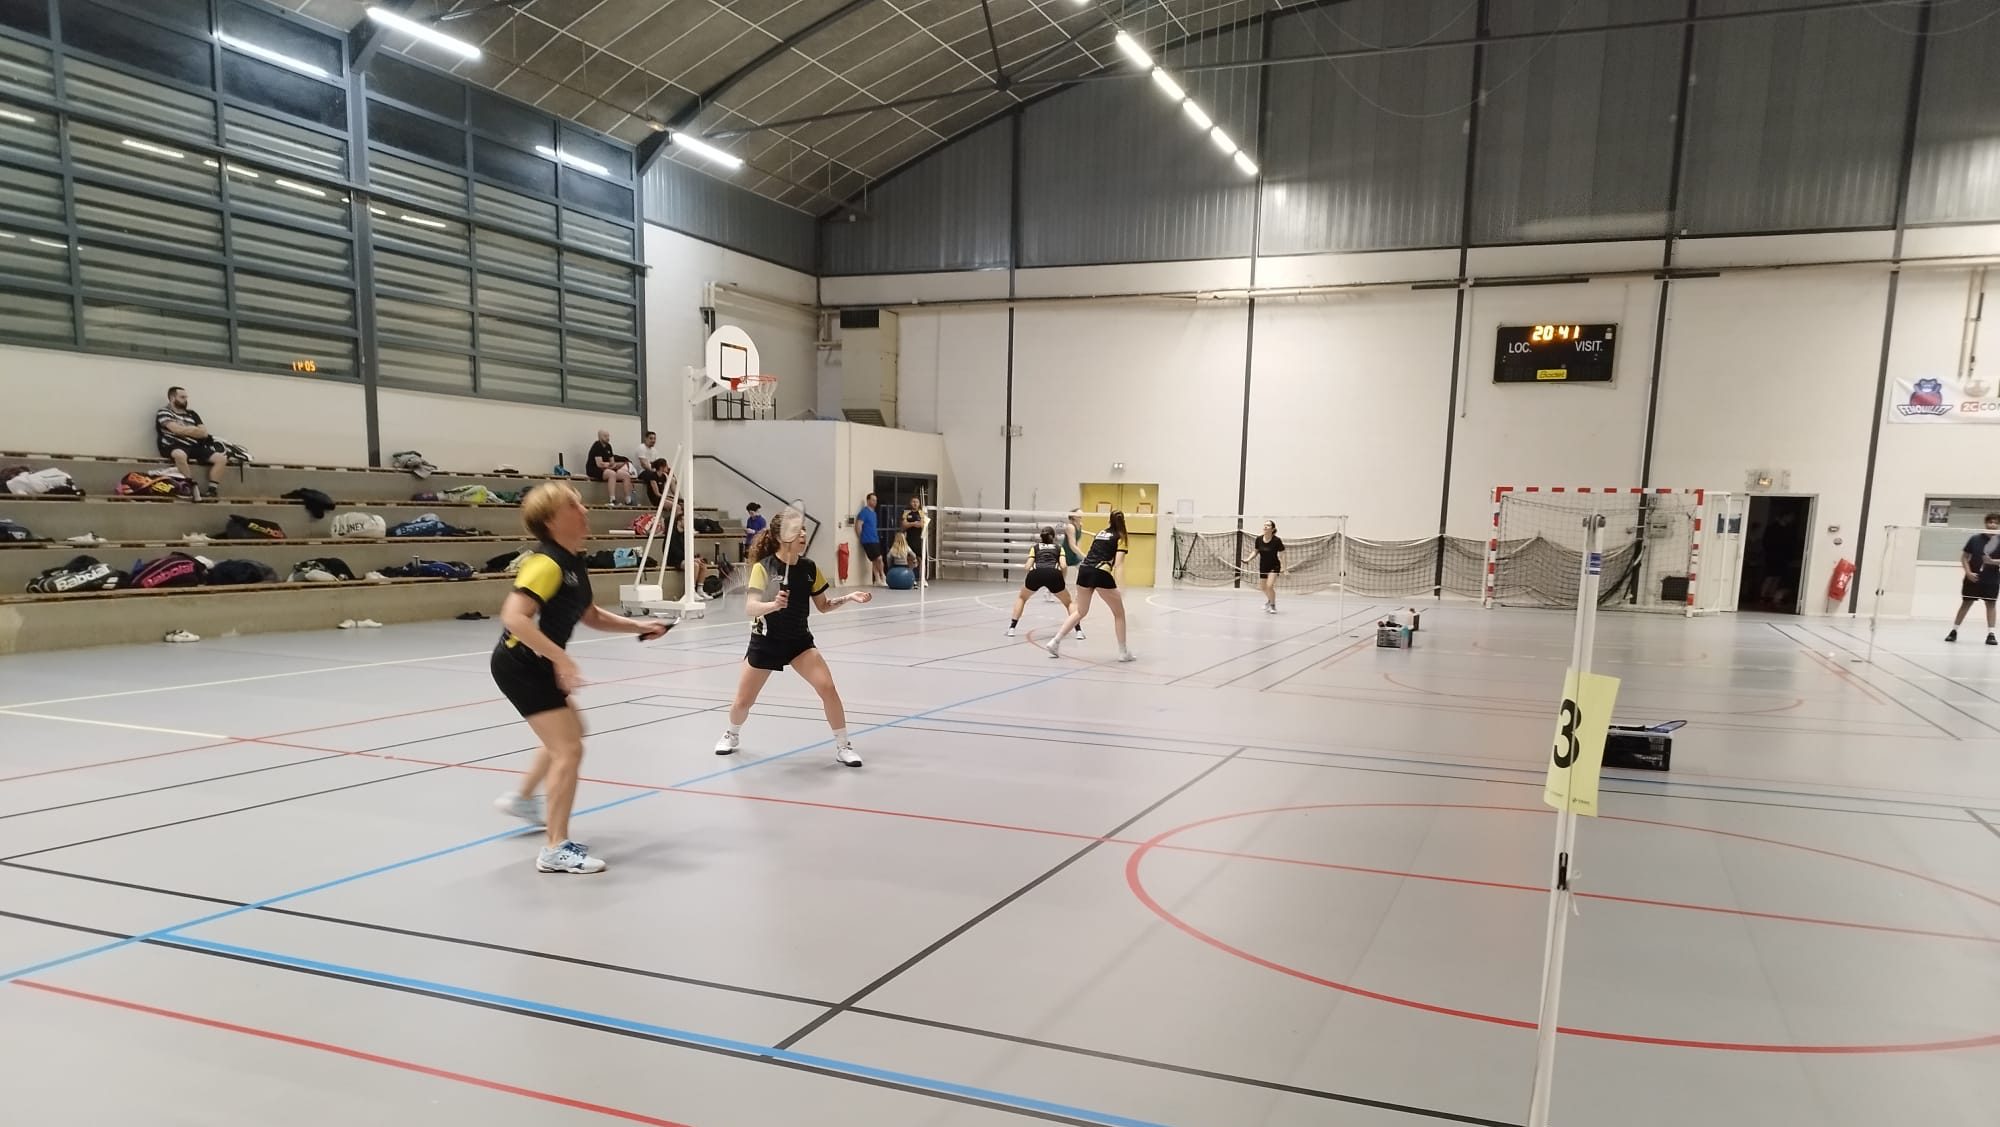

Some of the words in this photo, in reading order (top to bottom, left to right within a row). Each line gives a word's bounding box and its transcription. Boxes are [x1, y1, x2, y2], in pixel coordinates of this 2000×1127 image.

[54, 564, 110, 591] Babolat
[143, 562, 194, 589] Babolat
[1554, 699, 1582, 769] 3
